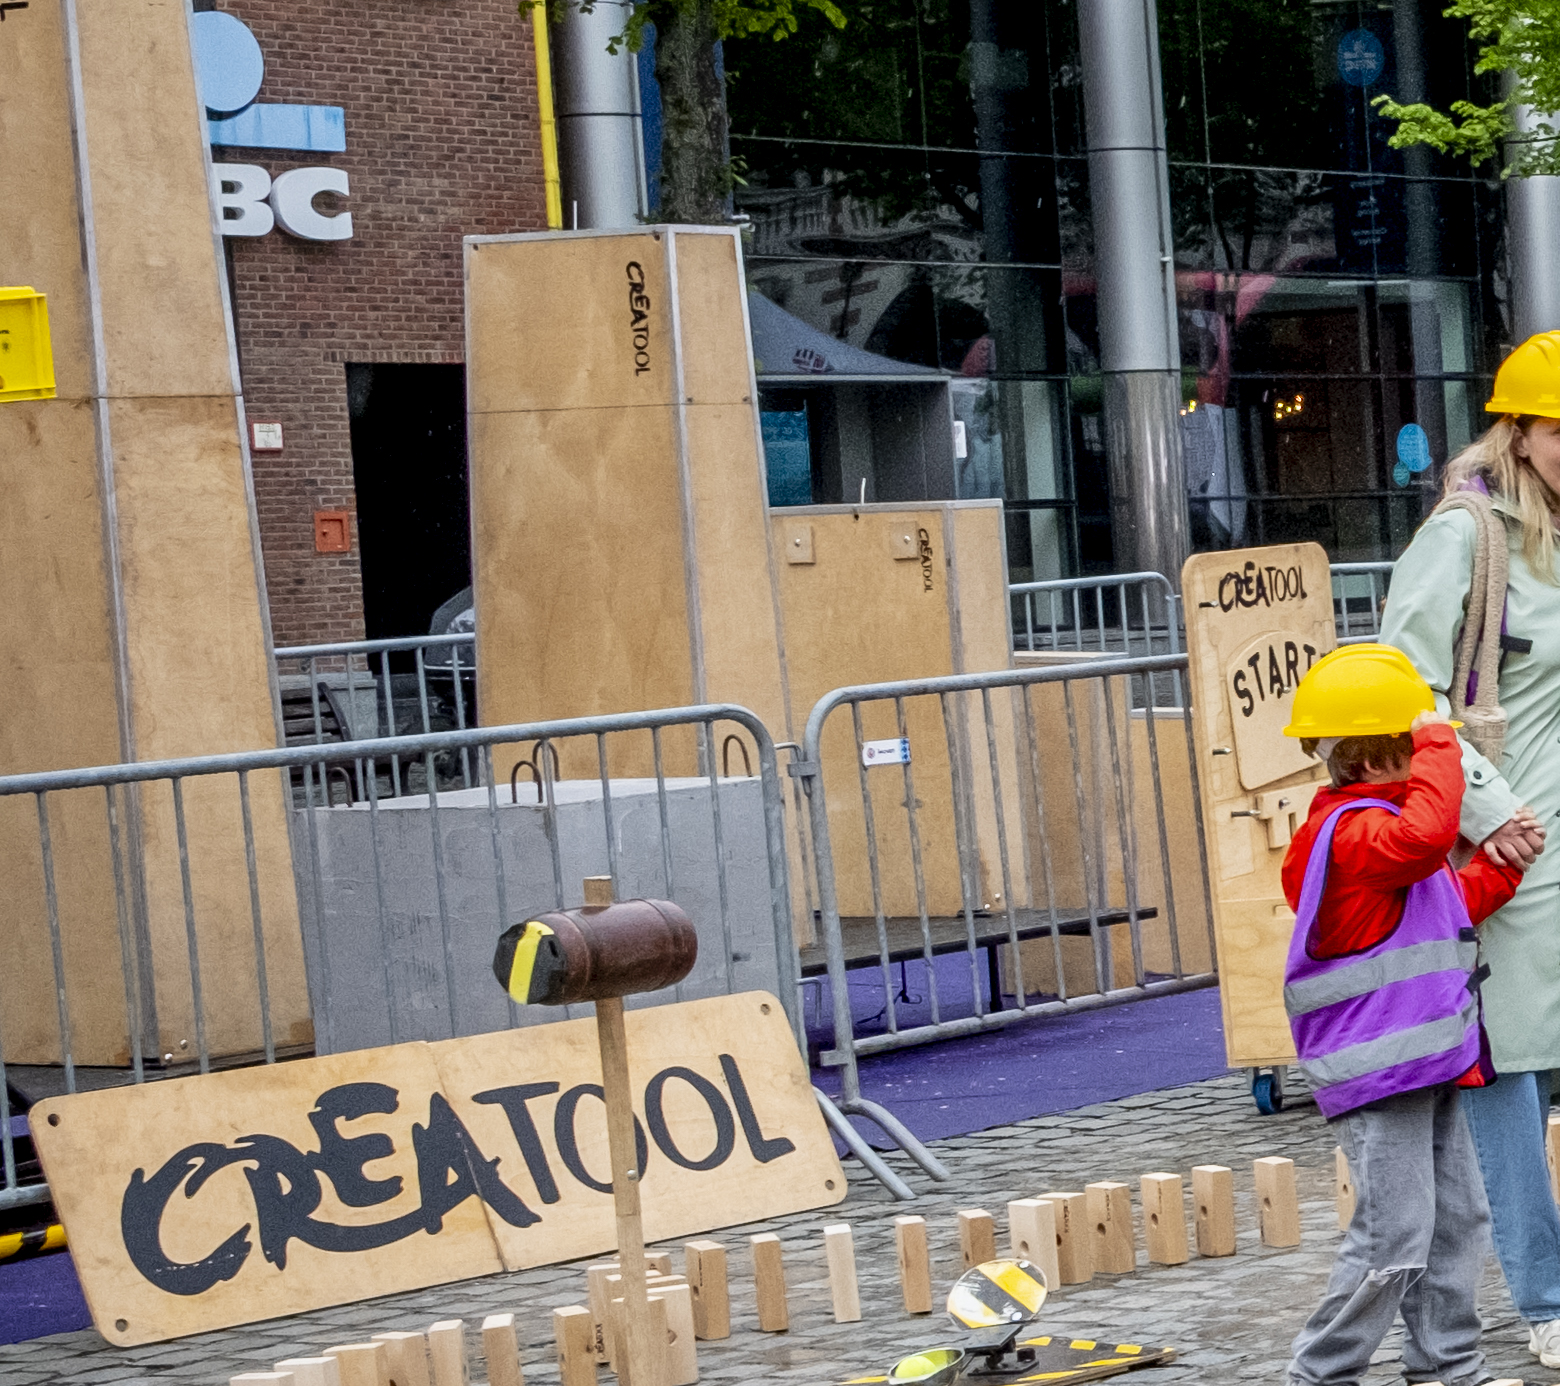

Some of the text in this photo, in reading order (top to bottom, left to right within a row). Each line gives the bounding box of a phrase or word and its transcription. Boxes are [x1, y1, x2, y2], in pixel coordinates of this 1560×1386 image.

[212, 163, 353, 241] BC
[626, 261, 650, 376] CREATOOL
[919, 528, 934, 593] CREATOOL
[1219, 561, 1307, 613] CREATOOL
[1233, 641, 1316, 717] START
[120, 1053, 796, 1296] CREATOOL
